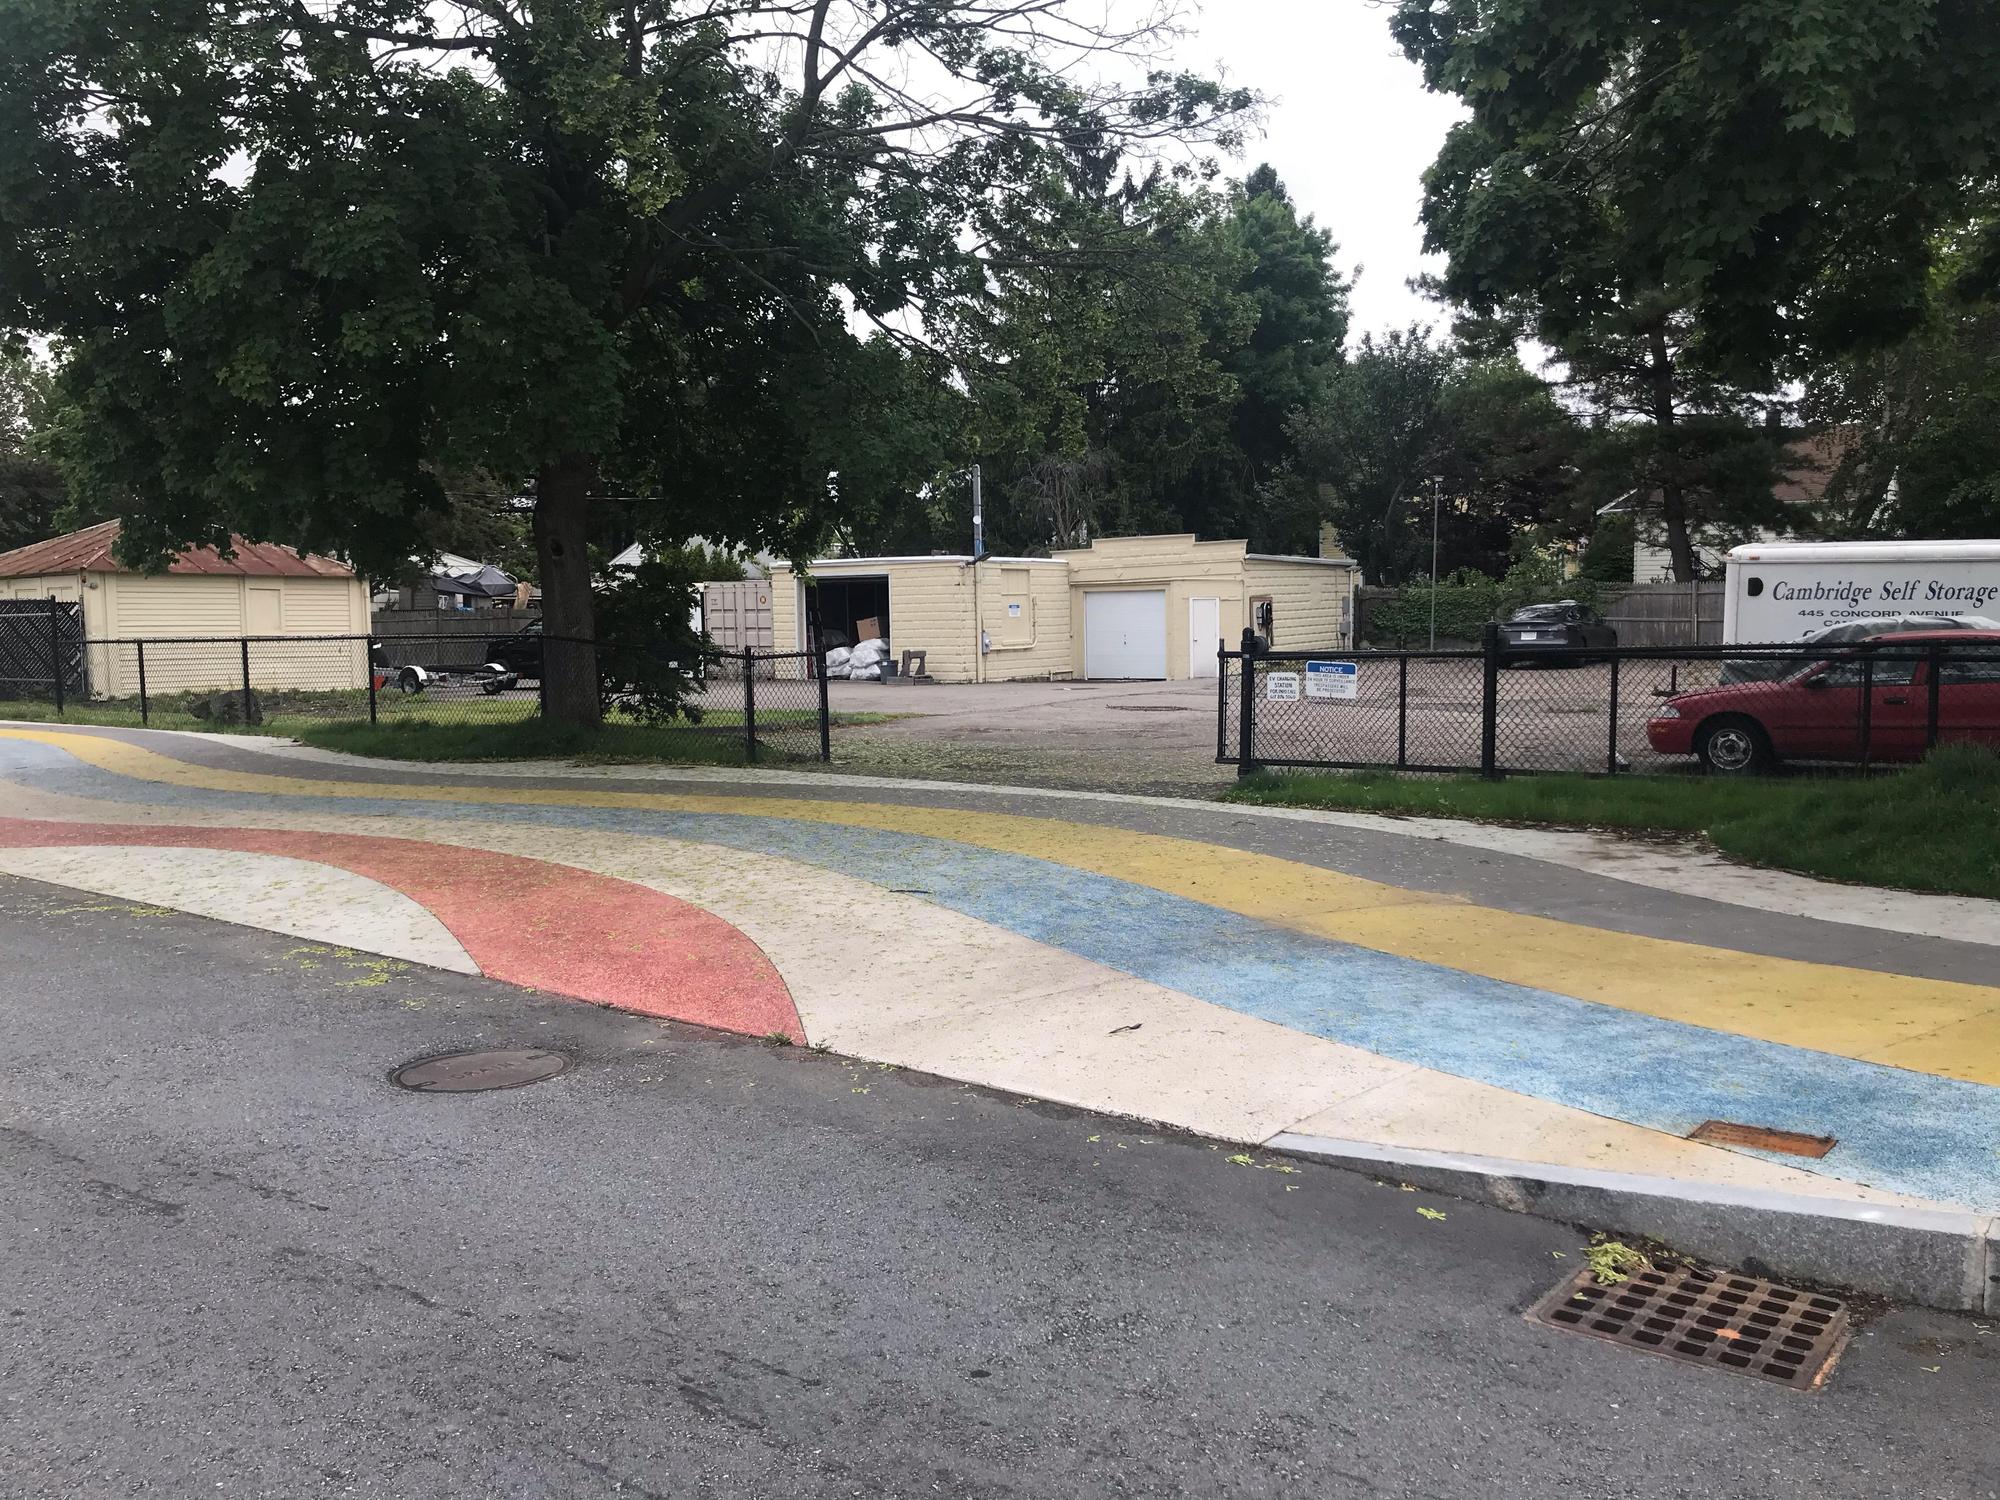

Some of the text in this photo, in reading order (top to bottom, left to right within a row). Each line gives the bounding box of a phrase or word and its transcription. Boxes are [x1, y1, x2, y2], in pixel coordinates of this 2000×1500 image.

[1773, 579, 1998, 608] Cambridge Self Storage
[1319, 665, 1344, 673] NOTICE
